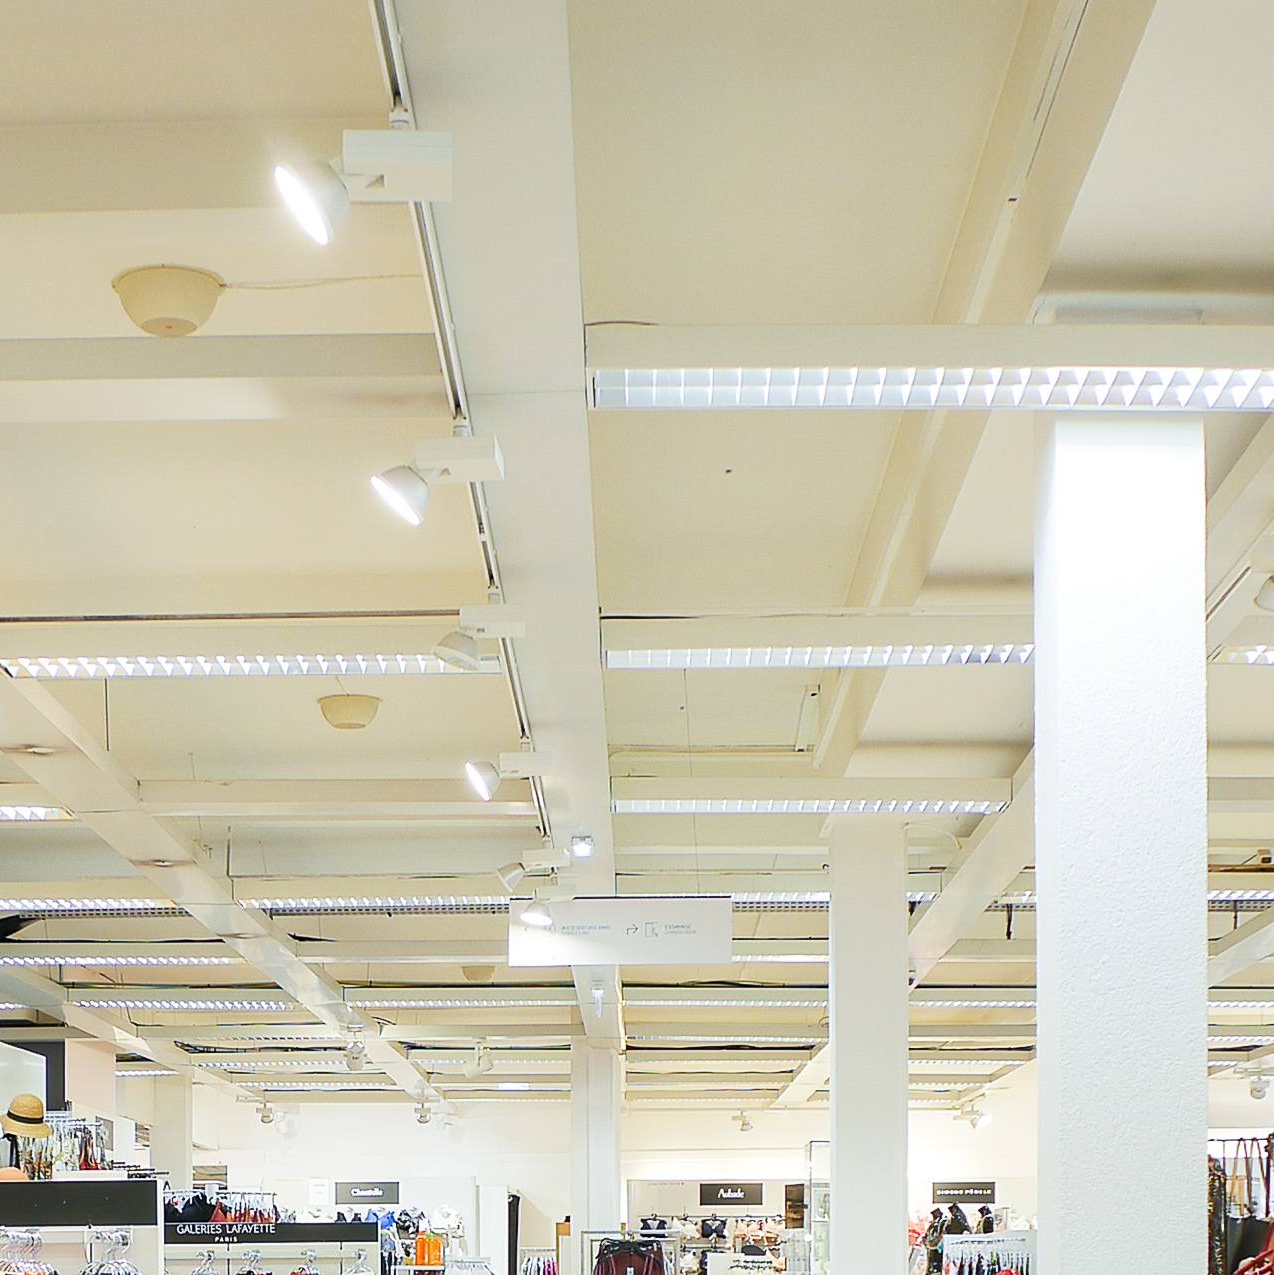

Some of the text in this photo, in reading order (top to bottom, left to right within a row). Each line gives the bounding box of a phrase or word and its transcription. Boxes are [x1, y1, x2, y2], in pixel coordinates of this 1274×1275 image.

[718, 1188, 745, 1199] Aubade
[176, 1223, 276, 1235] GALERIES LAFAYETTE
